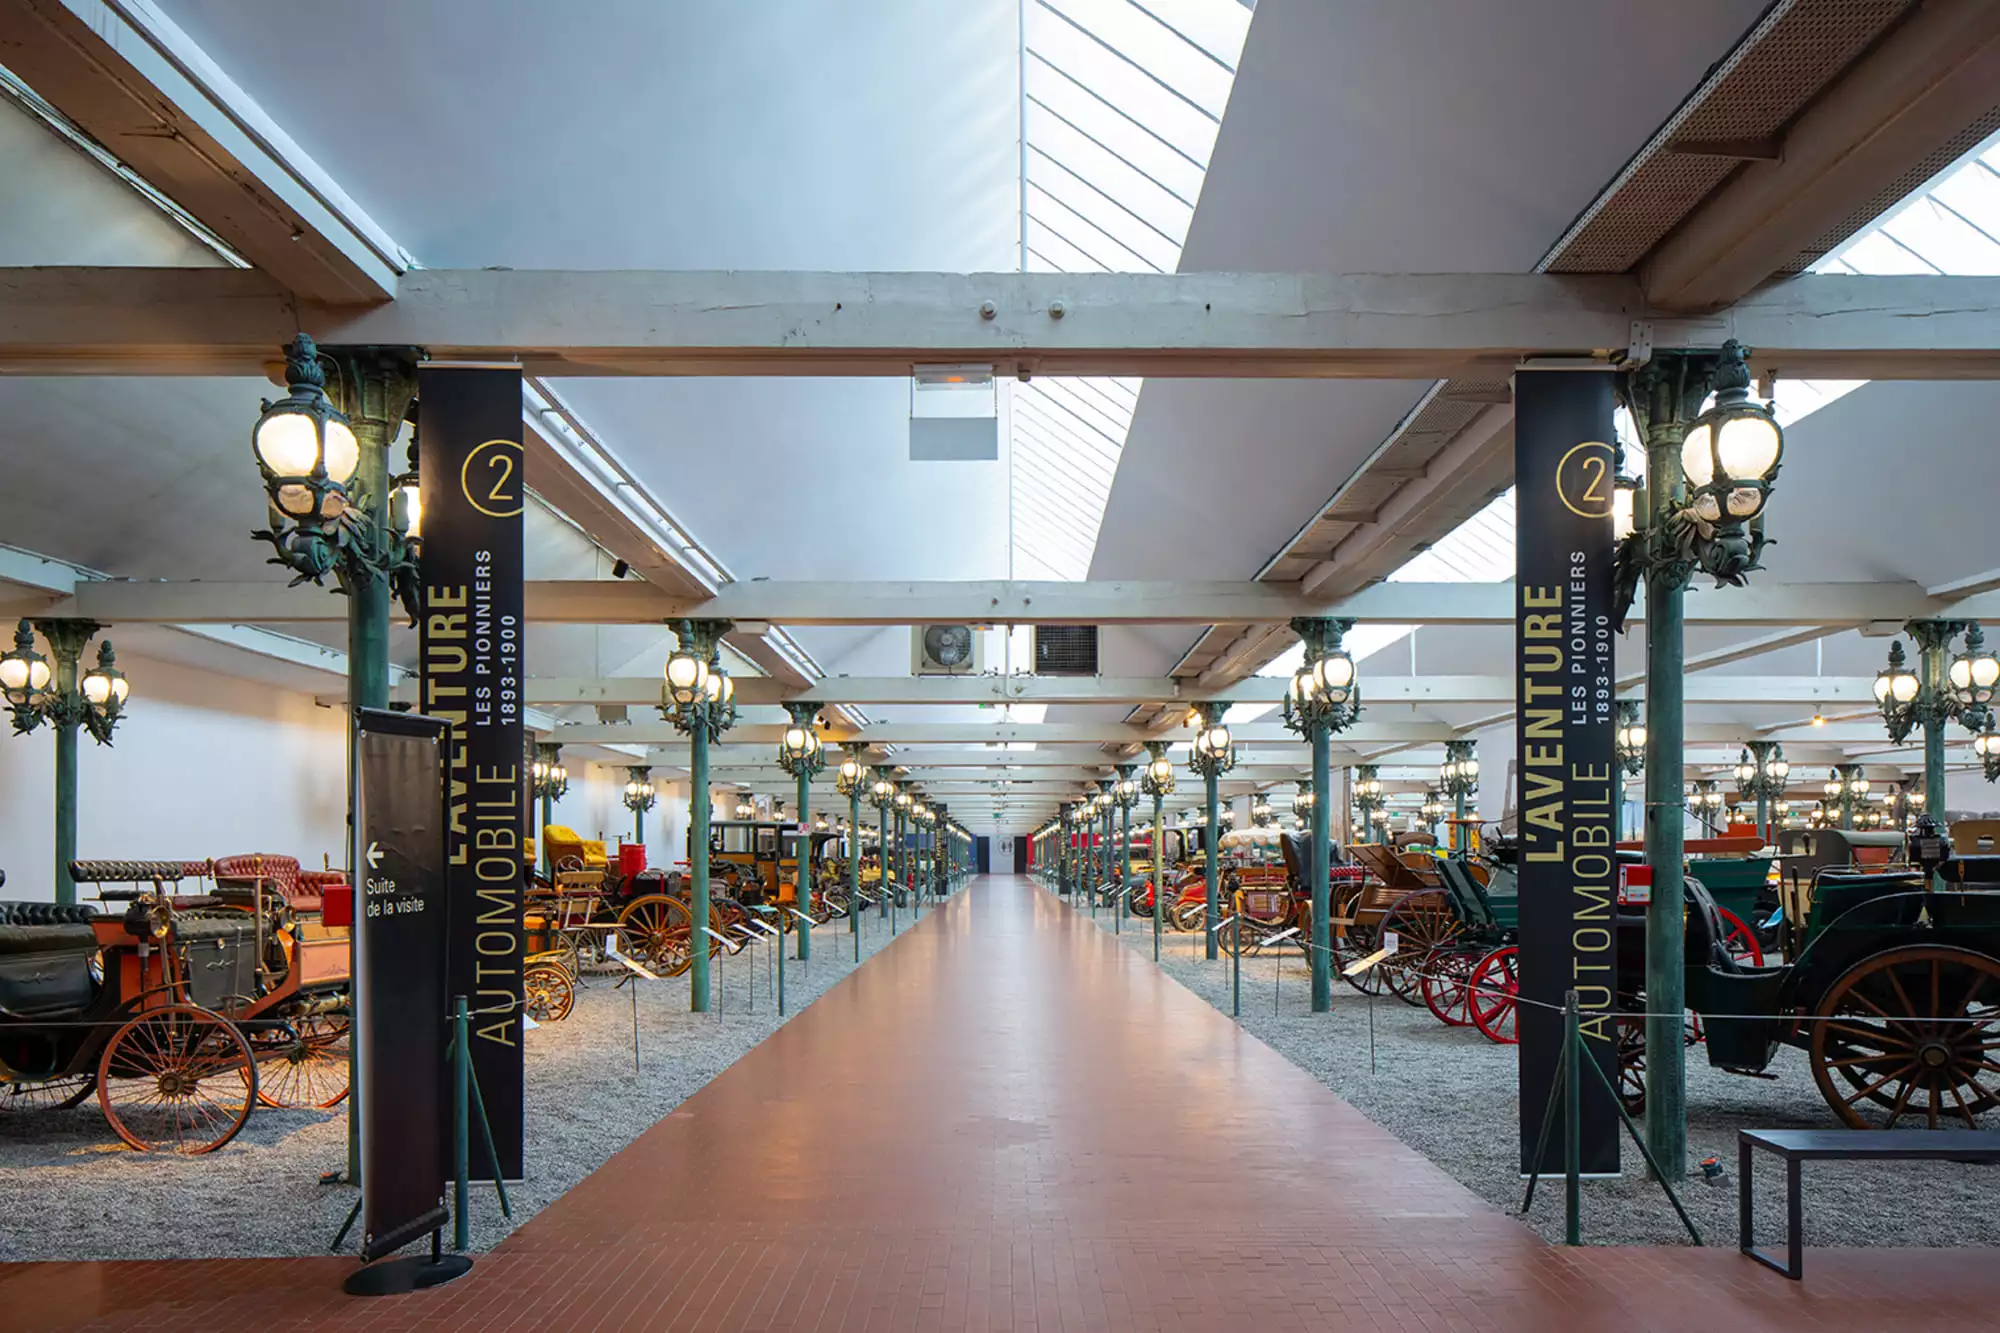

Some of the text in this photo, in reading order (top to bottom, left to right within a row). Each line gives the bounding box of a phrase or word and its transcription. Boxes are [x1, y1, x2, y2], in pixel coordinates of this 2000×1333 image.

[489, 454, 513, 500] 2
[1582, 455, 1606, 502] 2
[475, 550, 491, 726] LES PIONNIERS
[501, 615, 517, 726] 1893-1900
[1570, 550, 1587, 725] LES PIONNIERS
[1596, 615, 1609, 724] 1893-1900
[1524, 586, 1564, 862] L'AVENTURE
[366, 877, 396, 896] Suite
[367, 895, 425, 918] de la visite
[475, 764, 516, 1048] AUTOMOBILE
[1572, 762, 1611, 1042] AUTOMOBILE
